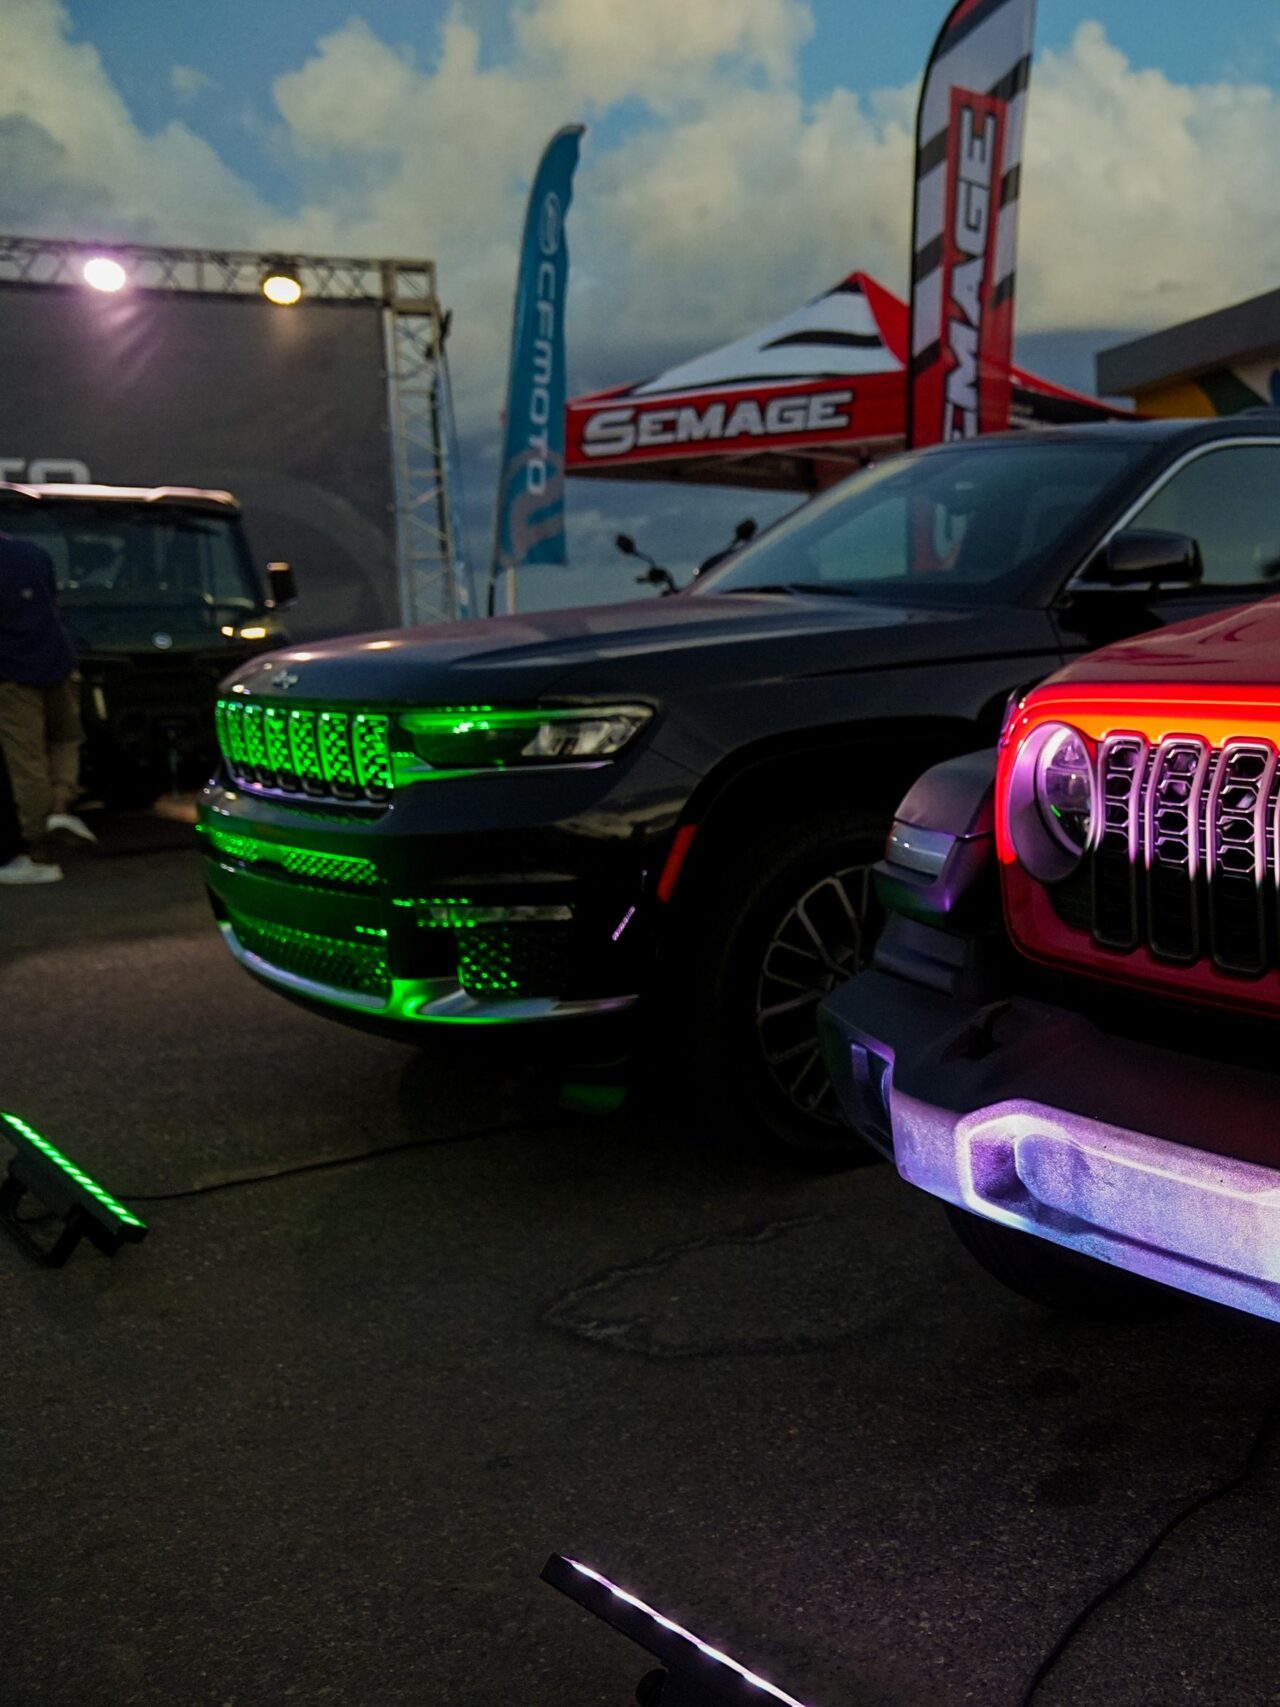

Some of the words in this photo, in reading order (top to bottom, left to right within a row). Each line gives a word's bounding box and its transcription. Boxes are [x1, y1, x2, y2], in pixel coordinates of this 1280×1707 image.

[526, 262, 556, 497] CFMOTO
[943, 107, 996, 441] MAGE
[581, 390, 853, 458] SEMAGE
